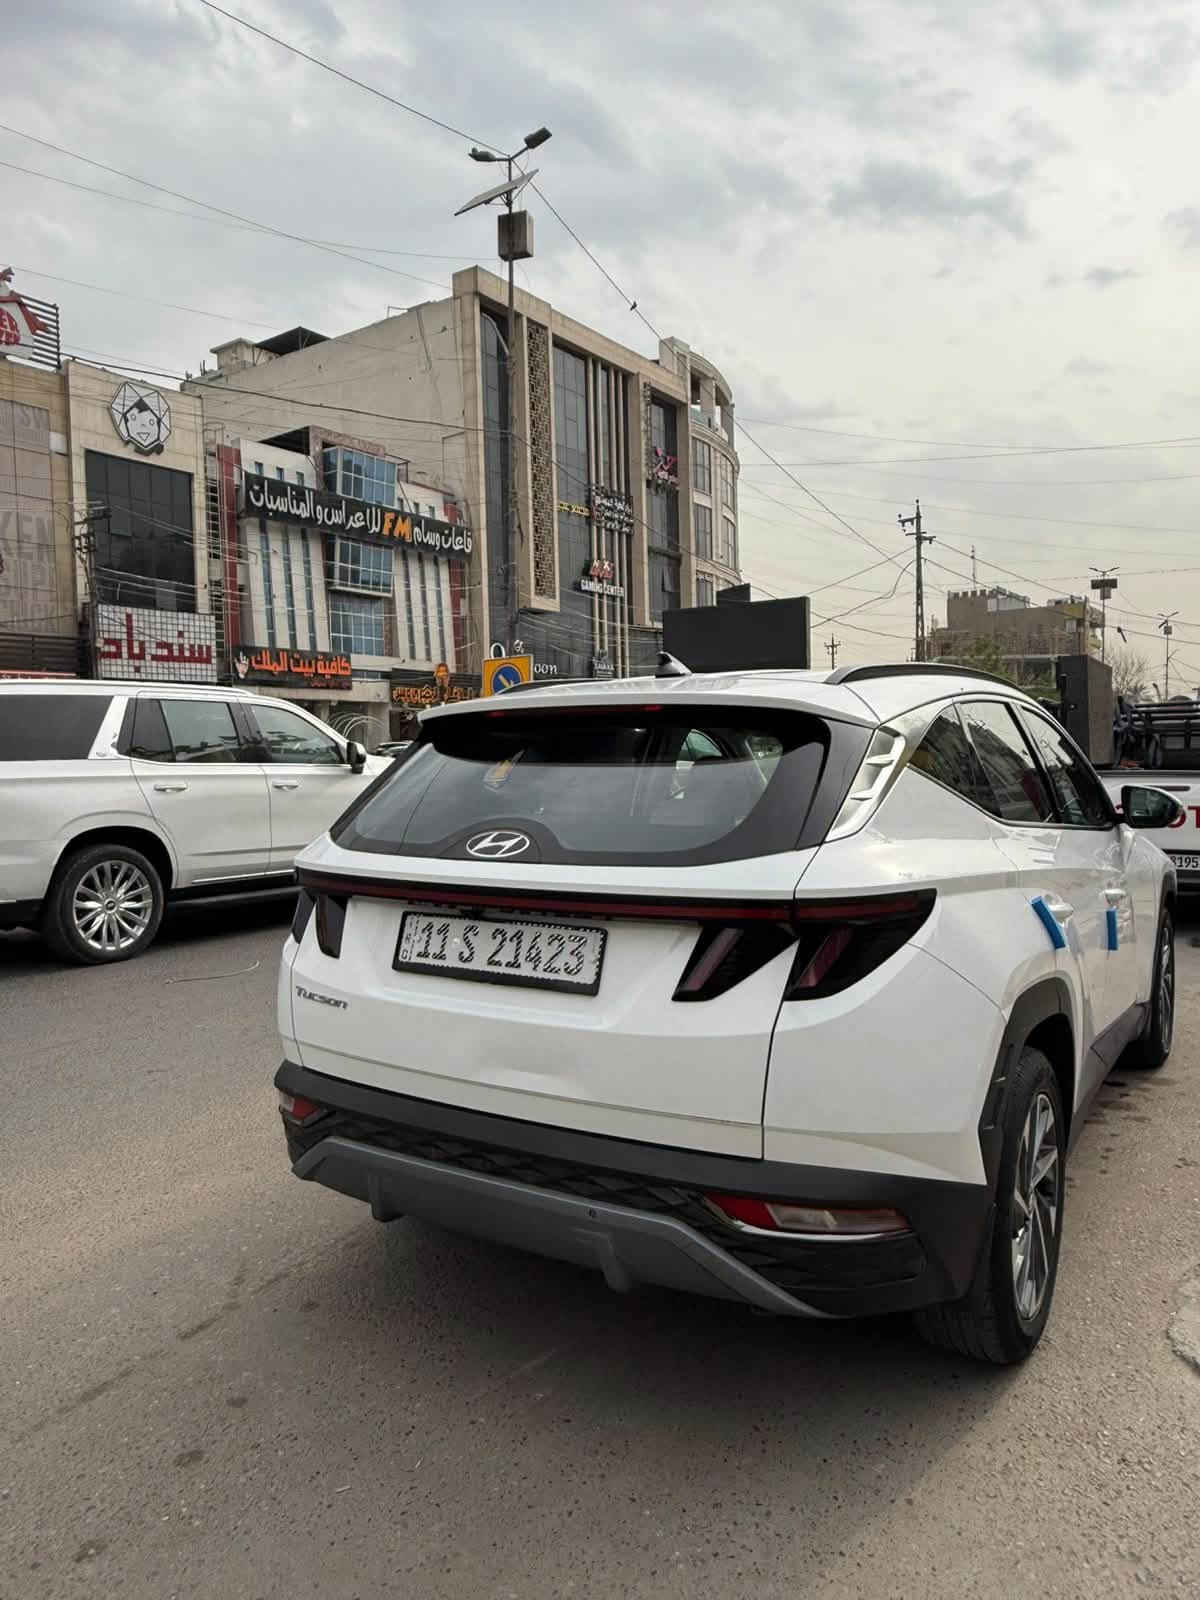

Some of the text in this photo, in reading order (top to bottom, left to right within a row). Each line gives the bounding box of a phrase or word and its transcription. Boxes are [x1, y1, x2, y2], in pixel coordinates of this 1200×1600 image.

[382, 511, 412, 543] FM
[414, 519, 441, 551] وسام
[443, 526, 473, 553] قاعات
[97, 612, 212, 673] سندباد
[251, 649, 288, 676] الملك
[290, 652, 316, 677] بيت
[415, 921, 450, 961] 11
[458, 924, 481, 964] S
[486, 927, 587, 976] 21423
